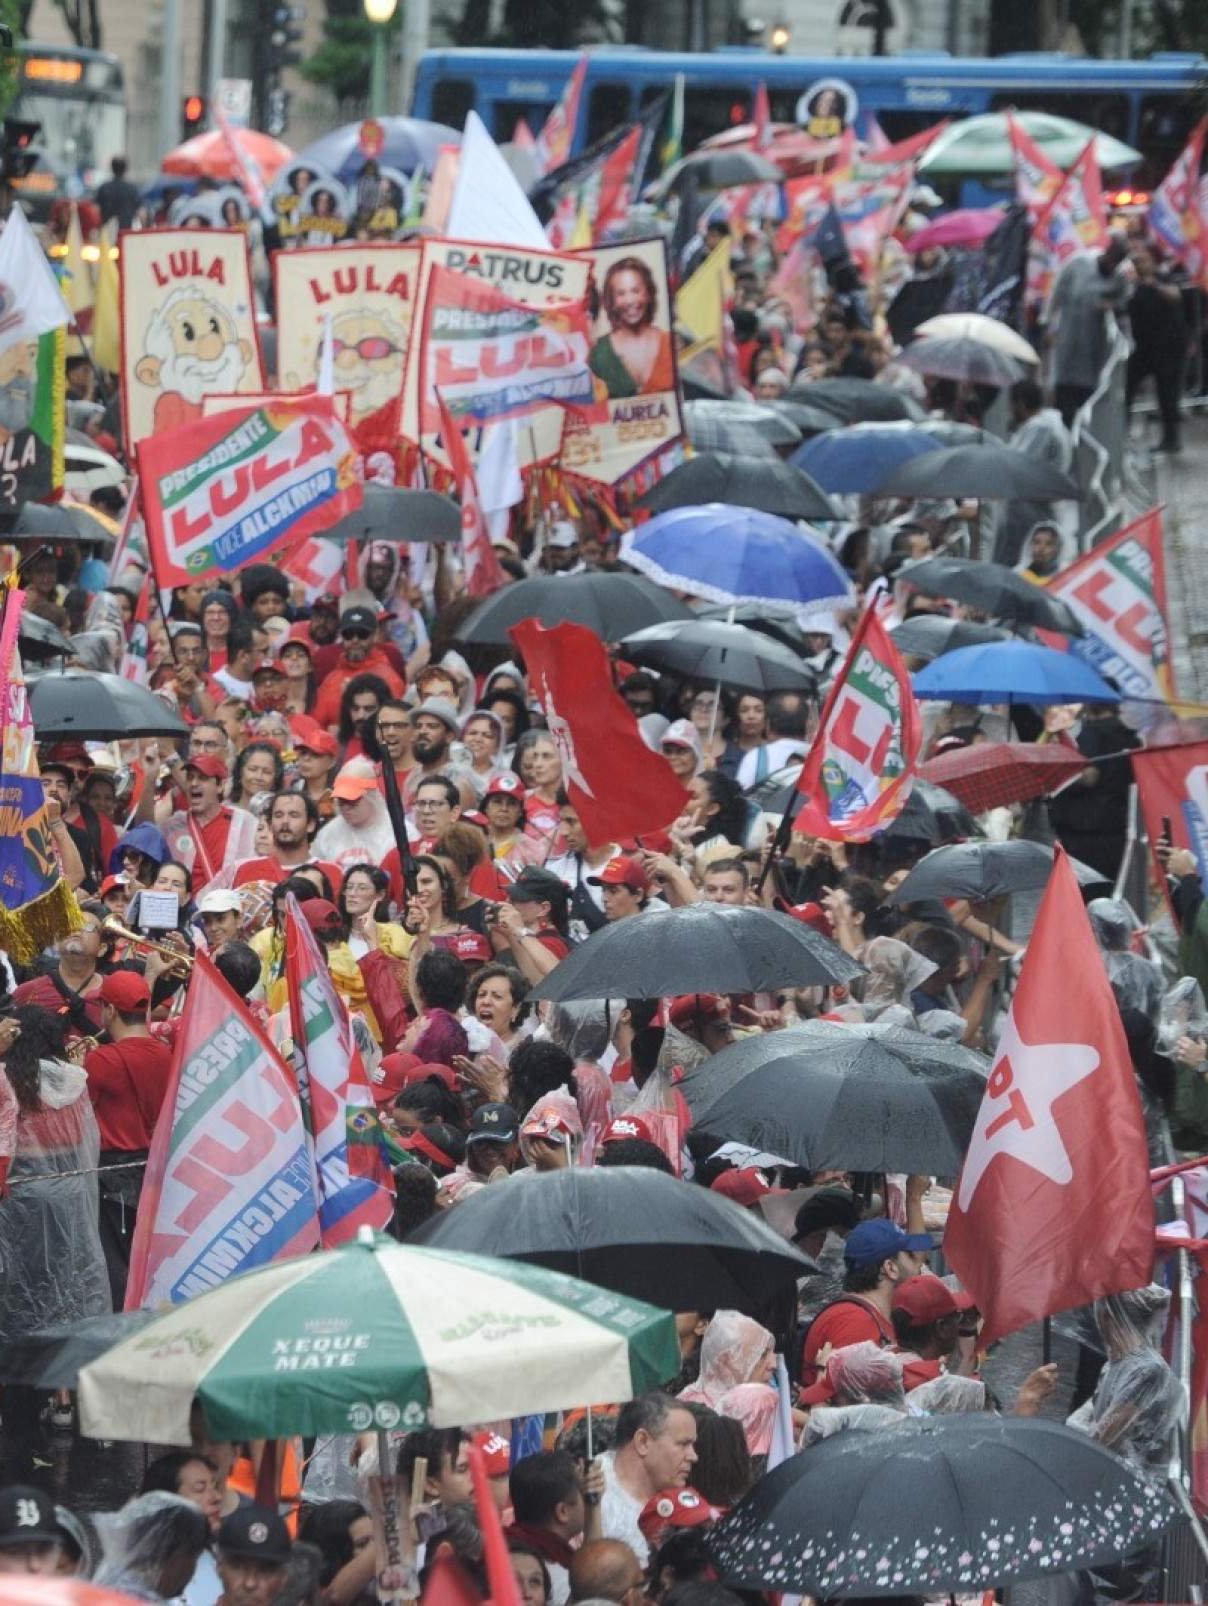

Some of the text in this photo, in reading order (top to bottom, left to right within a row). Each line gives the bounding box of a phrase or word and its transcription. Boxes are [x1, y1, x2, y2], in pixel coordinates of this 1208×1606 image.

[152, 250, 225, 287] LULA
[310, 265, 410, 304] LULA
[446, 250, 565, 288] PATRUS
[435, 336, 575, 385] LUL
[159, 411, 268, 498] PRESIDENTE
[172, 419, 333, 547] LULA
[214, 468, 333, 561] VICE ALCKMIN
[984, 1053, 1035, 1141] PT
[273, 1333, 372, 1355] XEQUE
[275, 1351, 359, 1371] MATE
